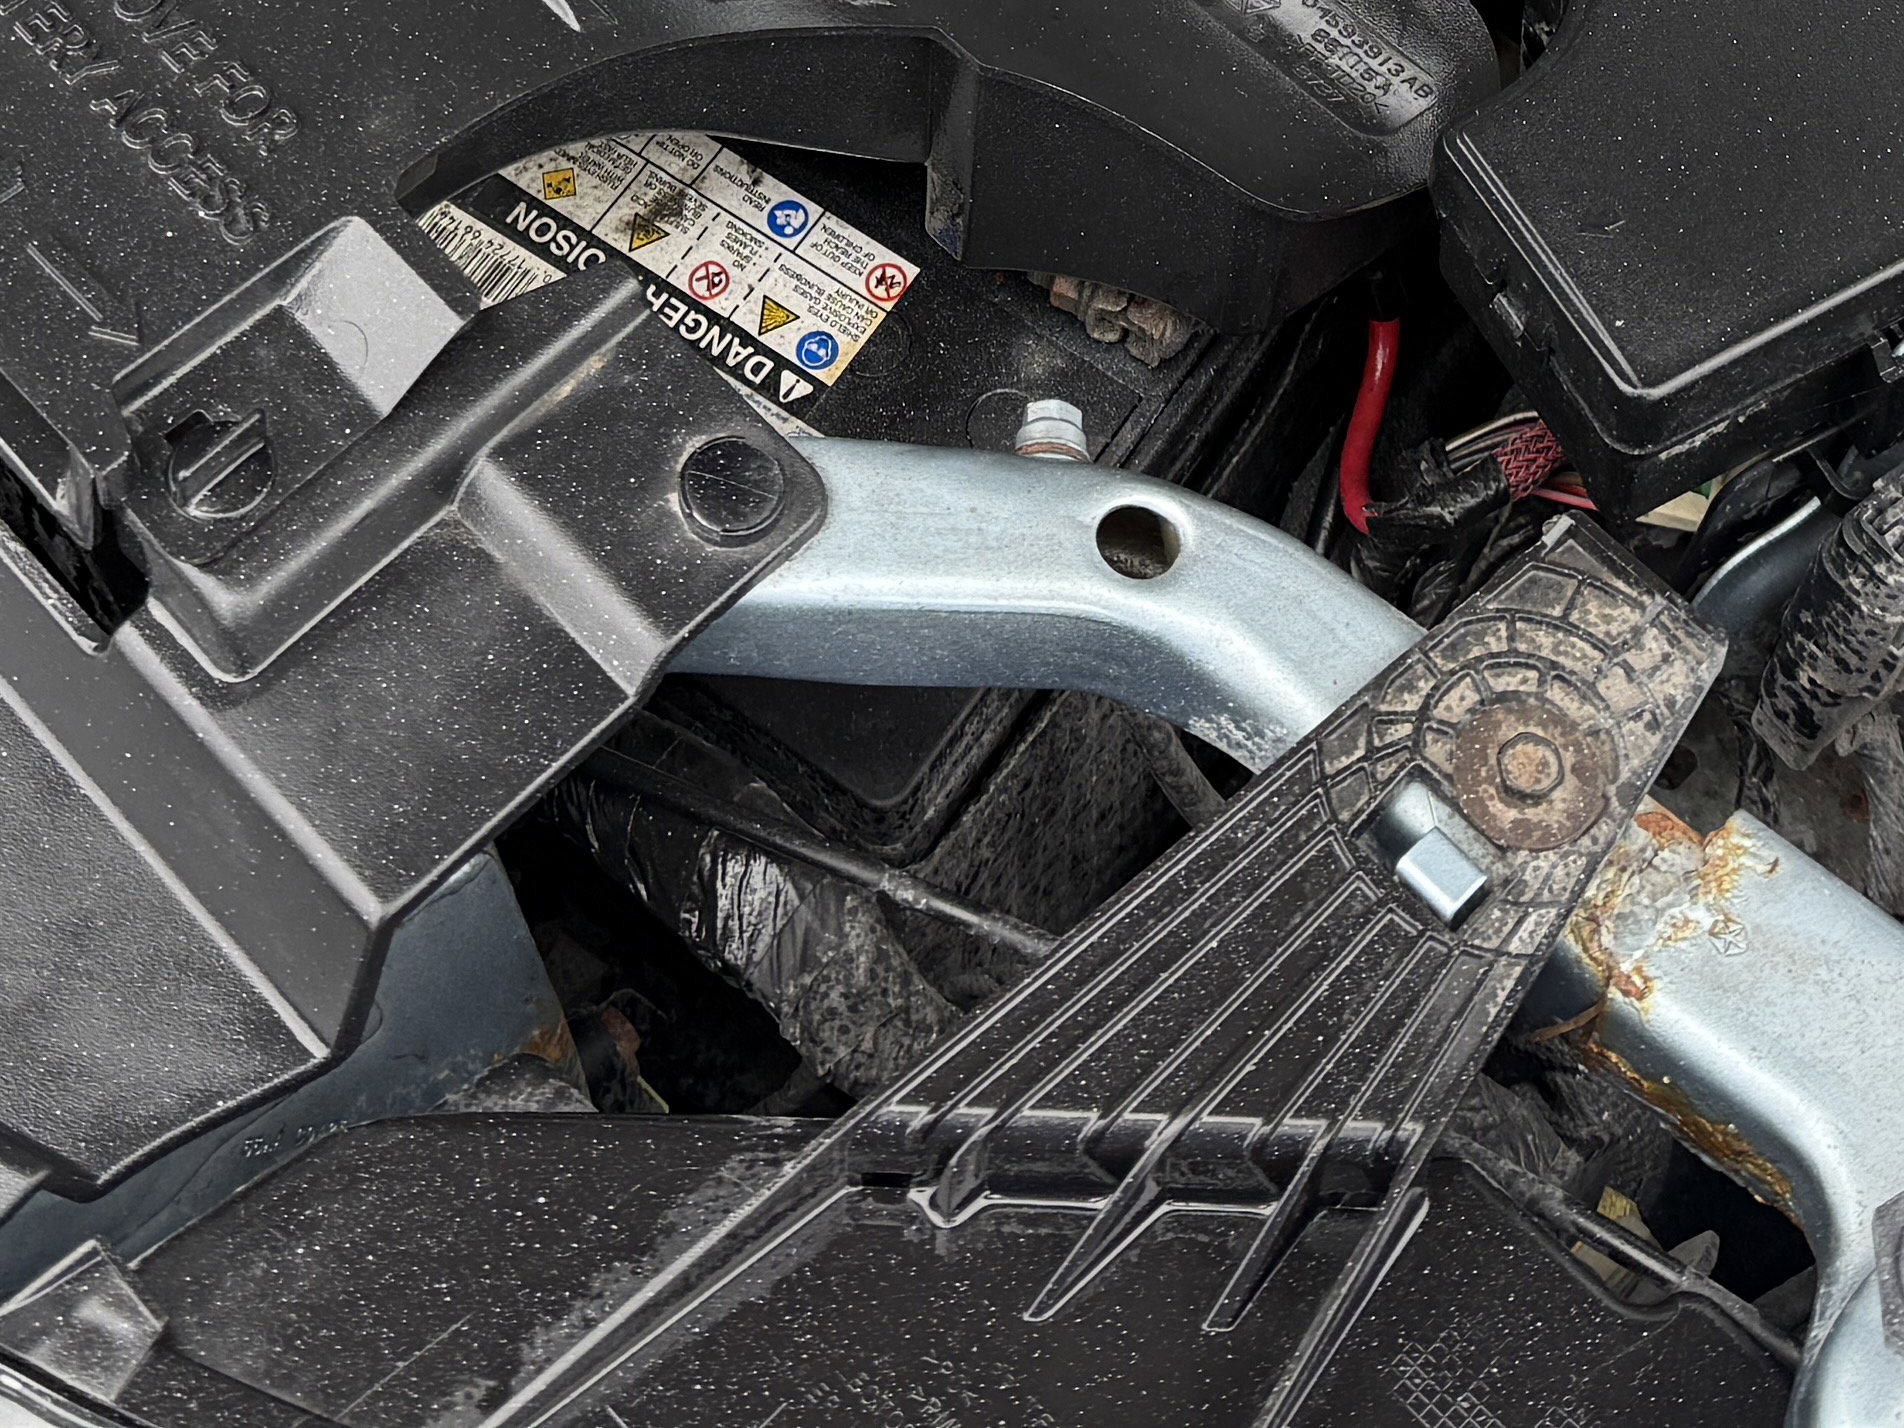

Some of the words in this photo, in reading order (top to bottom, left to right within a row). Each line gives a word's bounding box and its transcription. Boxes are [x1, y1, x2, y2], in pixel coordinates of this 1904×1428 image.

[194, 61, 298, 155] FOR
[667, 147, 689, 163] NOT
[91, 89, 269, 247] ACCESS
[740, 193, 766, 212] READ
[725, 220, 765, 248] SMOKING
[725, 231, 759, 255] FLAMES
[483, 237, 527, 270] 17724
[809, 239, 823, 251] OF
[821, 236, 854, 260] REACH
[821, 247, 841, 263] OUT
[861, 249, 876, 262] OF
[731, 259, 746, 271] NO
[839, 259, 863, 277] KEEP
[850, 255, 869, 270] THE
[777, 263, 825, 296] BLINDNESS
[792, 284, 821, 305] GASES
[823, 292, 854, 314] CAUSE
[833, 286, 865, 309] INJURY
[820, 302, 866, 334] EXPLOSIVE
[853, 311, 873, 326] CAN
[863, 306, 879, 319] OR
